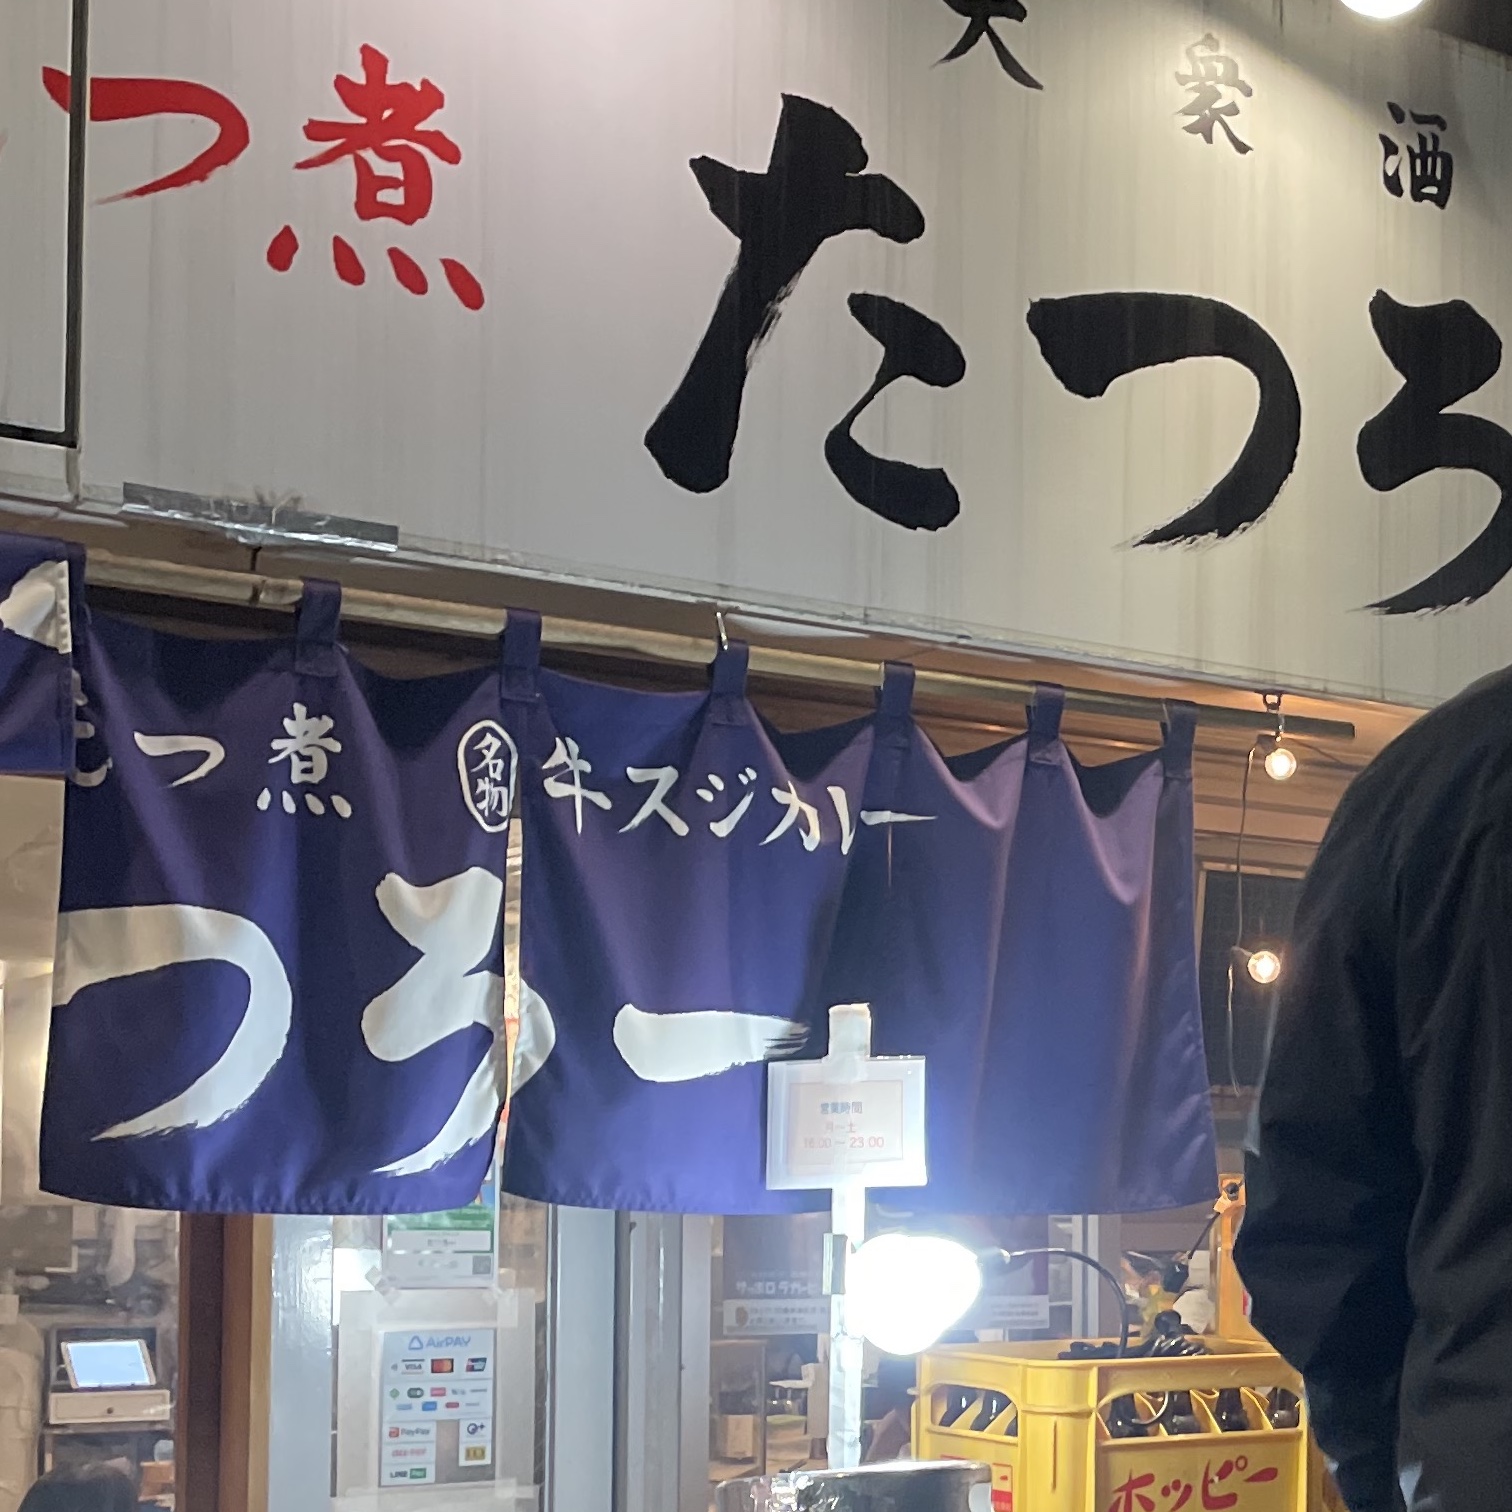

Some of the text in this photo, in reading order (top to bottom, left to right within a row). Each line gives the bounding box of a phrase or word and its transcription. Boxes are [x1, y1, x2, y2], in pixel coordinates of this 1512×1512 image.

[474, 732, 508, 818] 名物
[541, 736, 938, 855] 牛スジカレー
[426, 1337, 471, 1348] AirPAY
